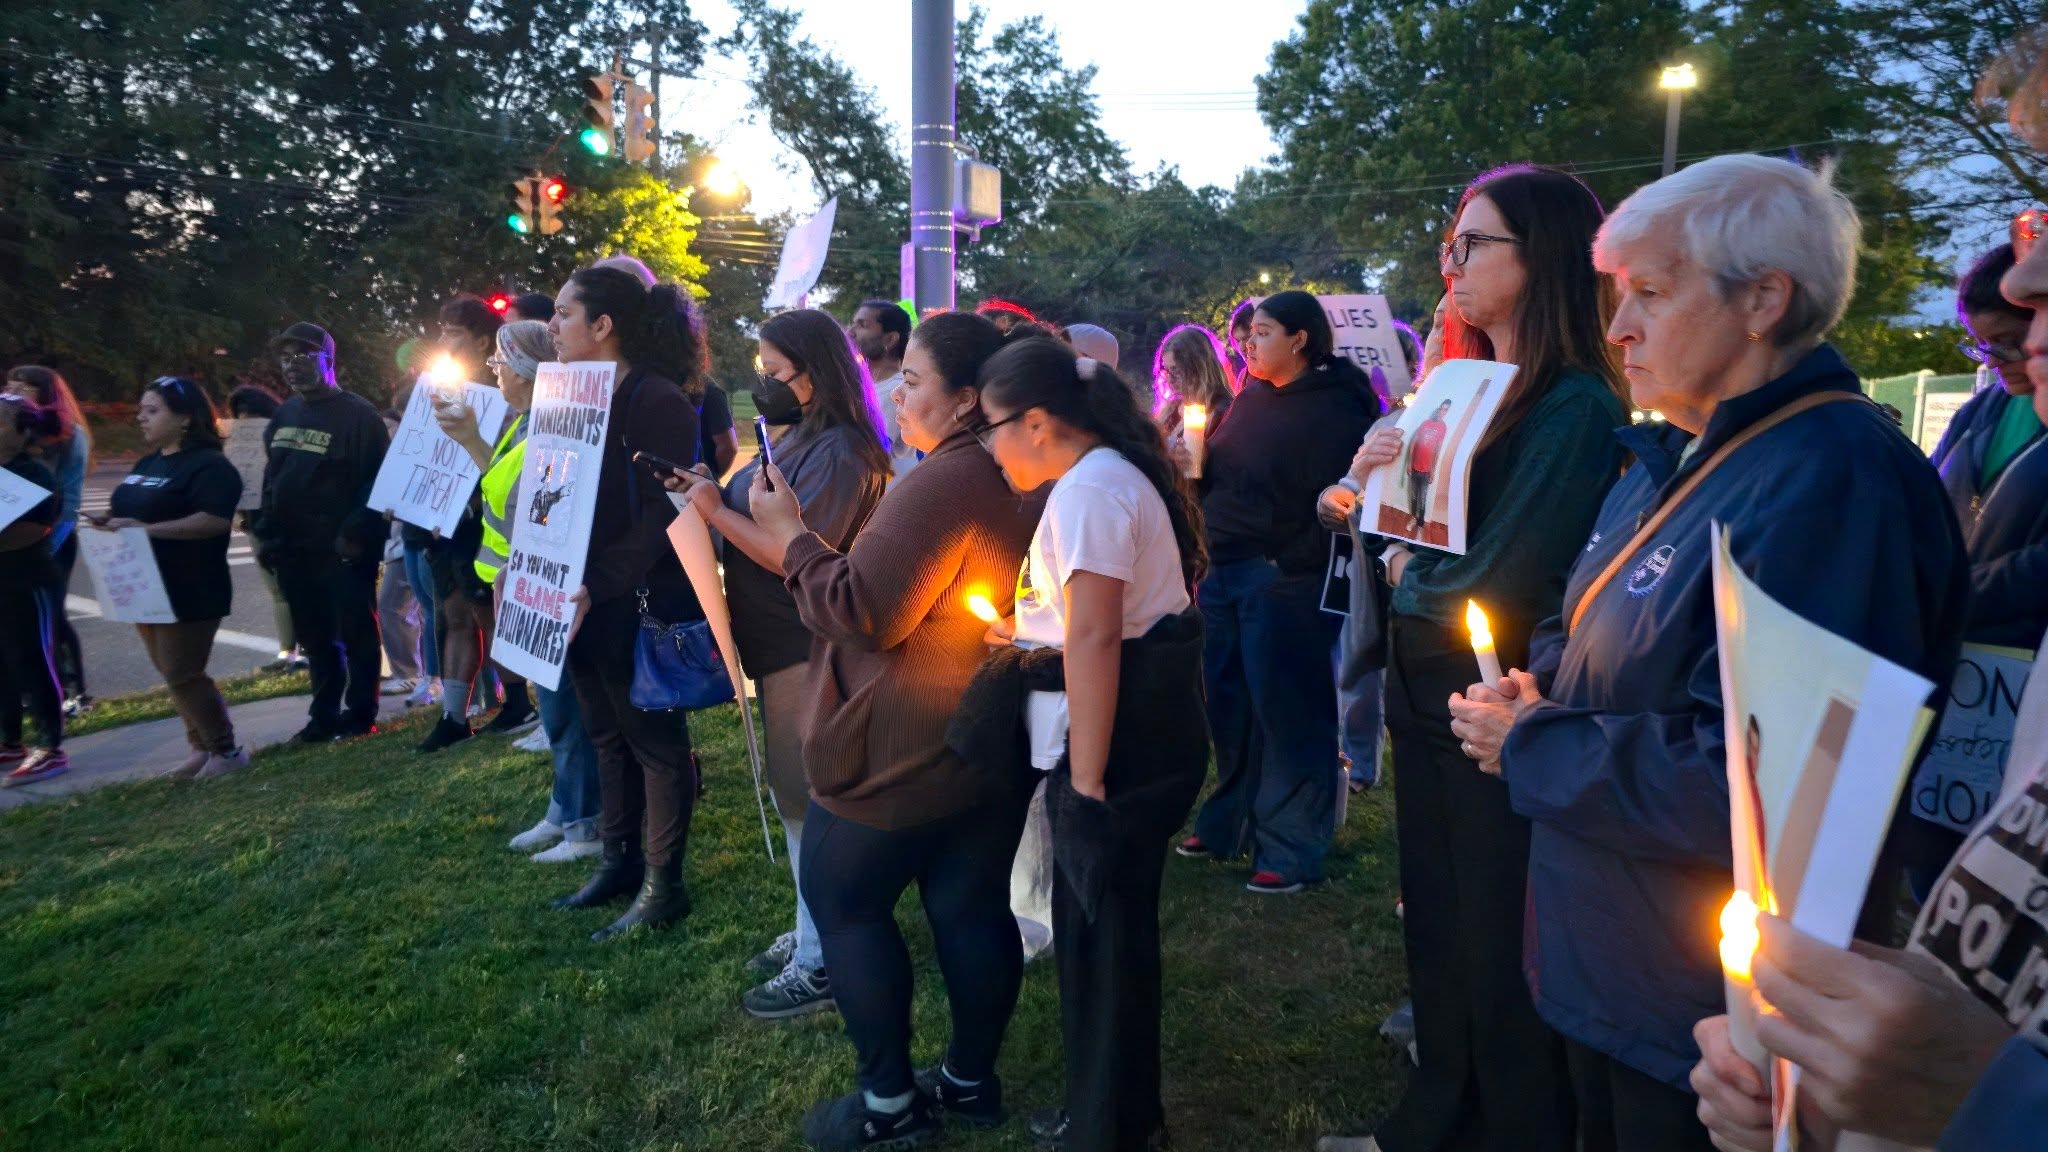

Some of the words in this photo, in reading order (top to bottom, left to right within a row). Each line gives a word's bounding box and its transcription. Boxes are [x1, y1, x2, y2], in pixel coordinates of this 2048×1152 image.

[398, 428, 425, 456] IS
[533, 406, 606, 447] IMMIGRANTS
[402, 463, 468, 519] THREAT
[510, 549, 523, 571] SO
[526, 553, 543, 576] YOU
[514, 577, 566, 620] BLAME
[497, 599, 569, 666] BILLIONAIRES
